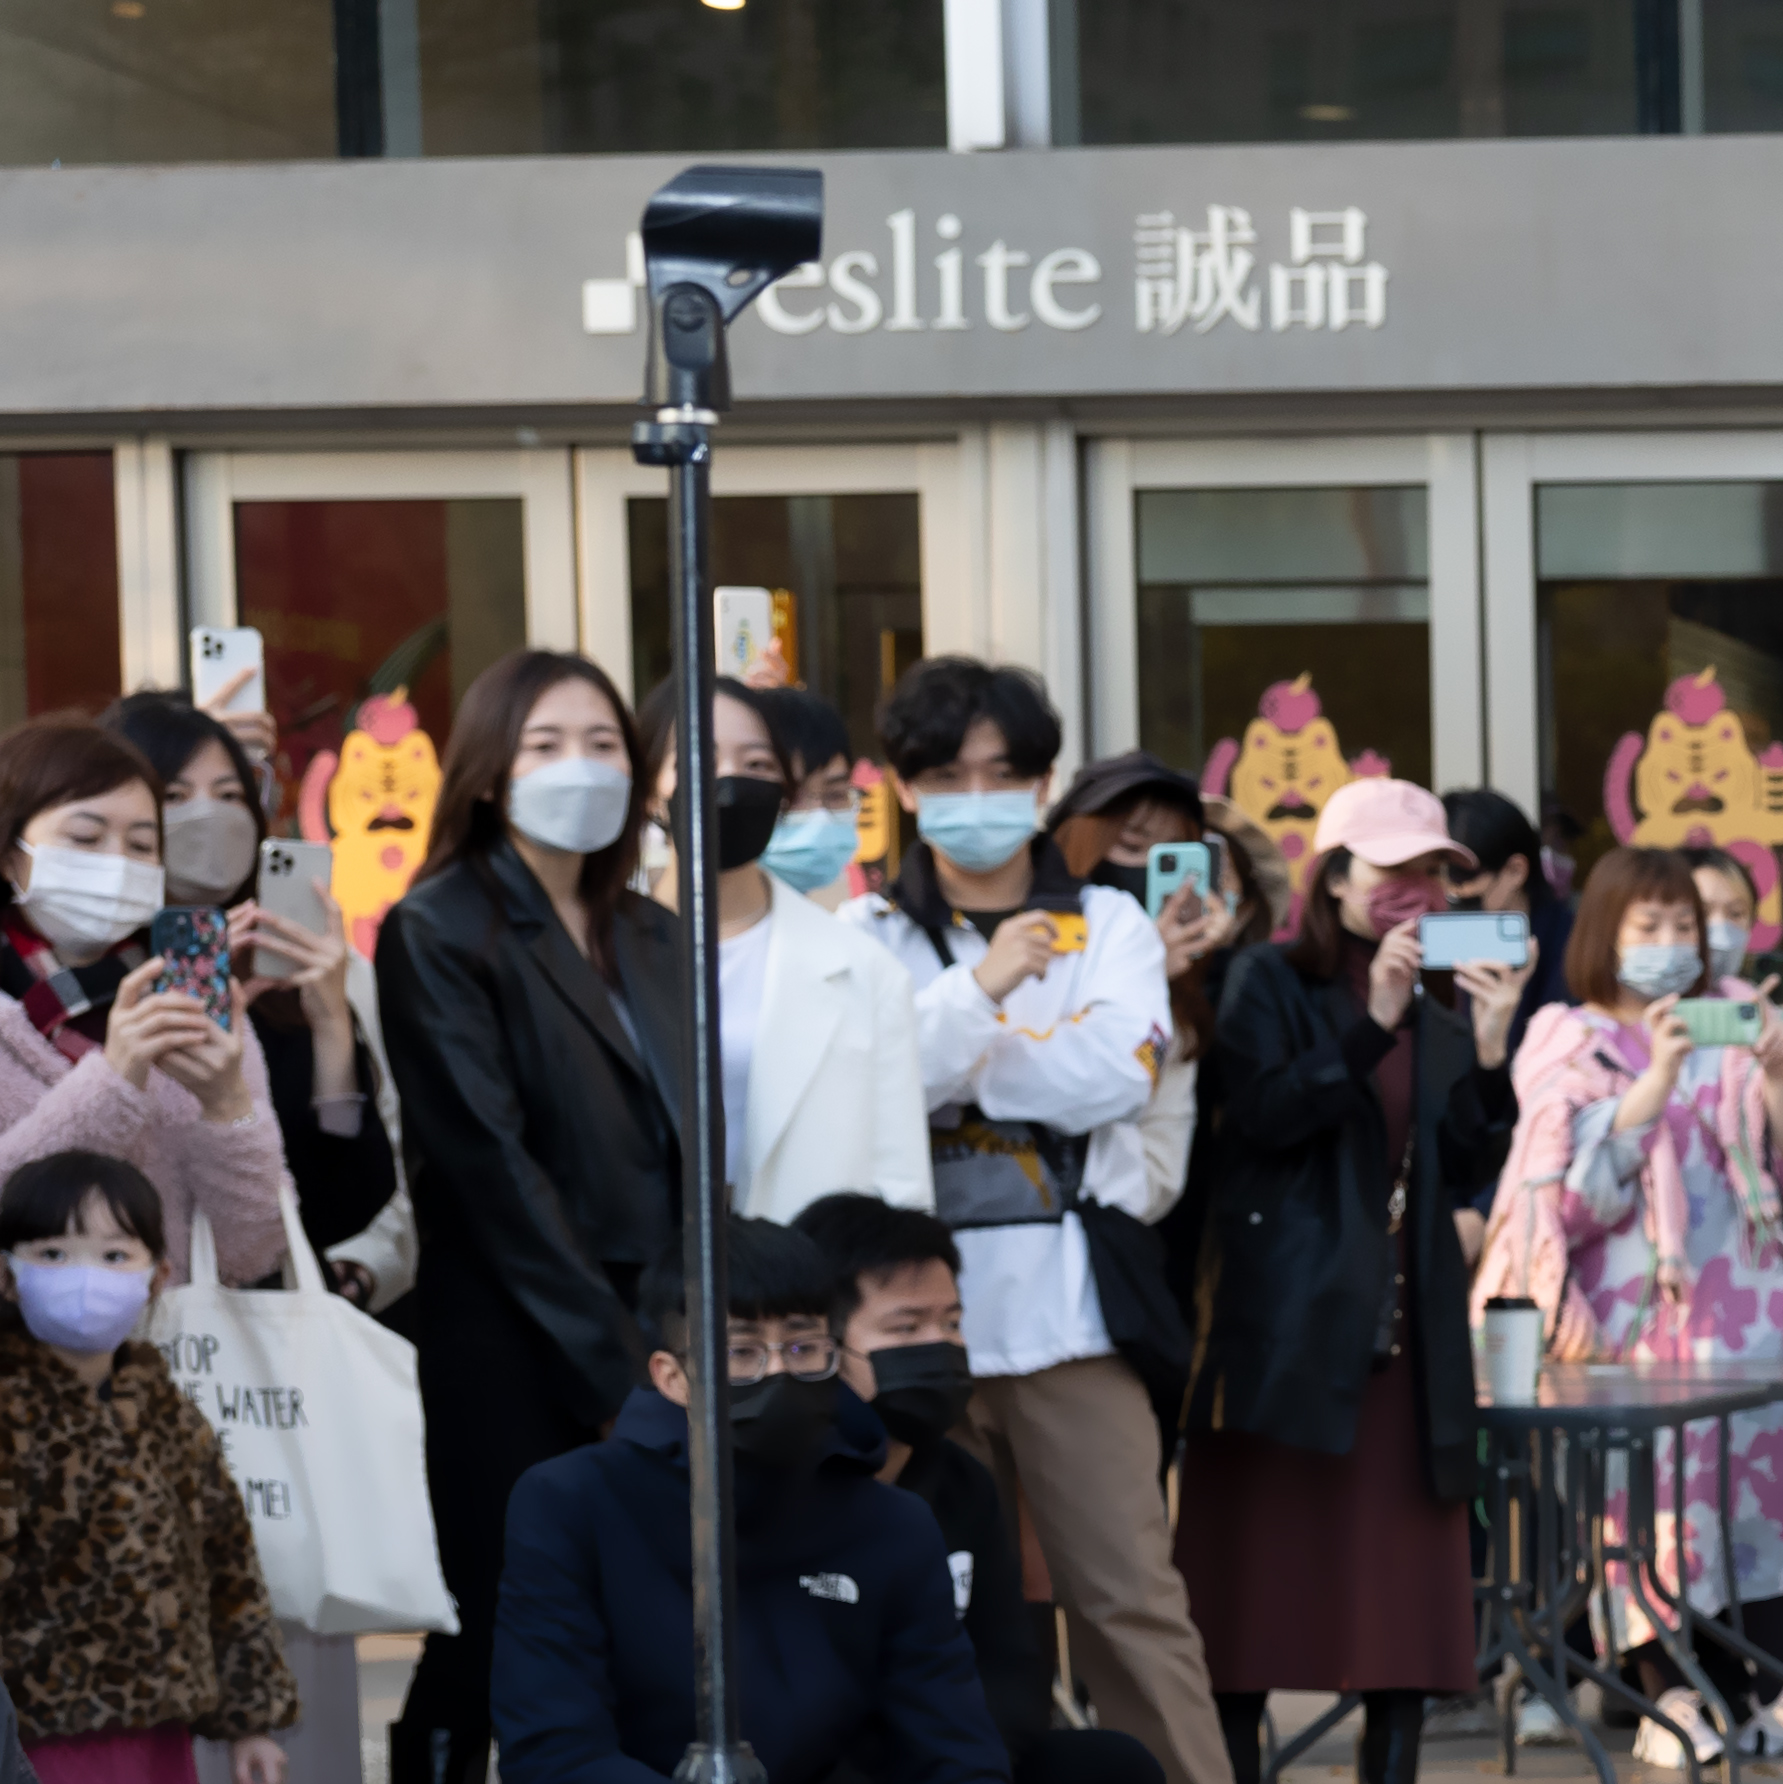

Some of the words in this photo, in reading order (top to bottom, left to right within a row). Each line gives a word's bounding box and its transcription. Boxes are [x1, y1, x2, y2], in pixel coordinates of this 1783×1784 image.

[754, 208, 1101, 335] eslite
[1134, 203, 1389, 333] 誠品
[158, 1333, 220, 1375] TOP
[215, 1382, 309, 1431] WATER
